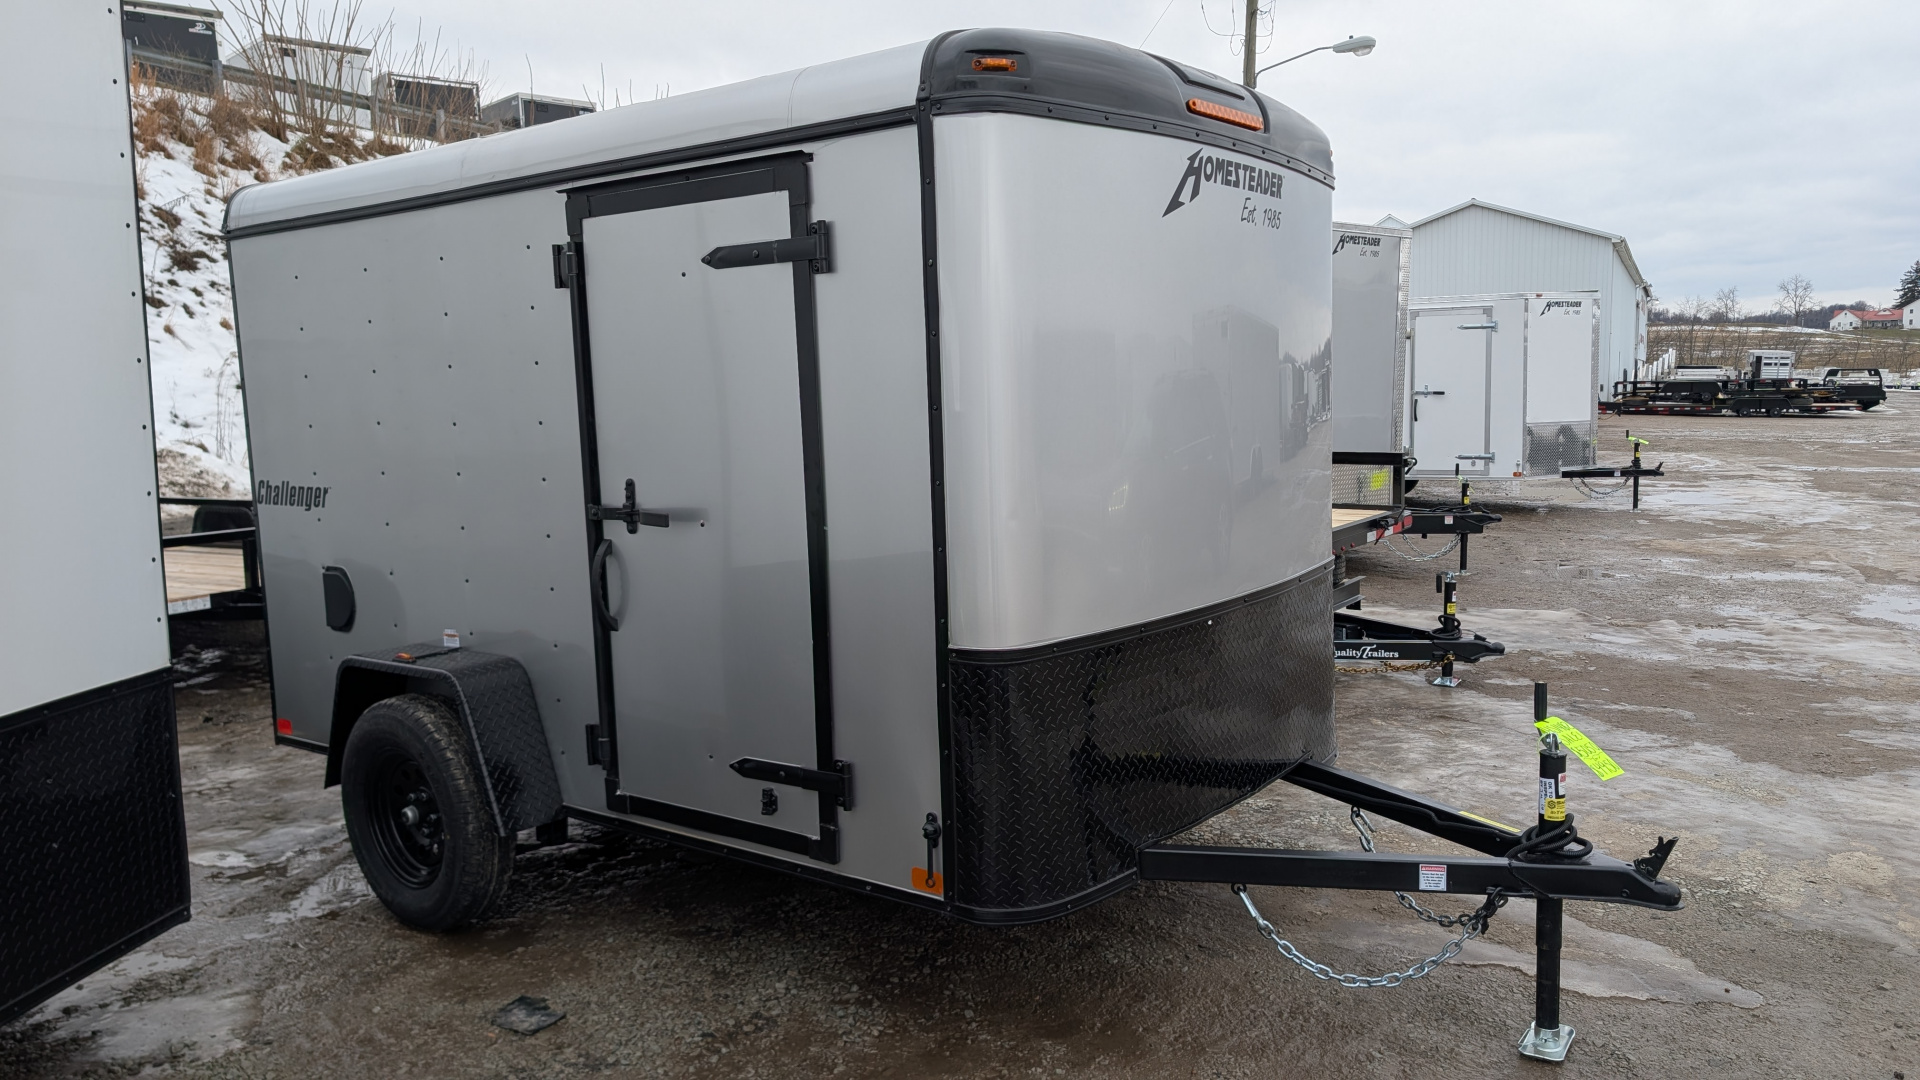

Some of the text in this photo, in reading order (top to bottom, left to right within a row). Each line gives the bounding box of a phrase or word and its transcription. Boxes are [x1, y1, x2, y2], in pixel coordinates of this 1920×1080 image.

[1162, 147, 1284, 219] HOMESTEADER
[1262, 208, 1282, 230] 1985
[1332, 233, 1381, 255] HOMESTEADER
[1539, 300, 1582, 317] HOMESTEADER
[257, 479, 329, 512] Challenger
[1334, 644, 1399, 659] uality Trailers
